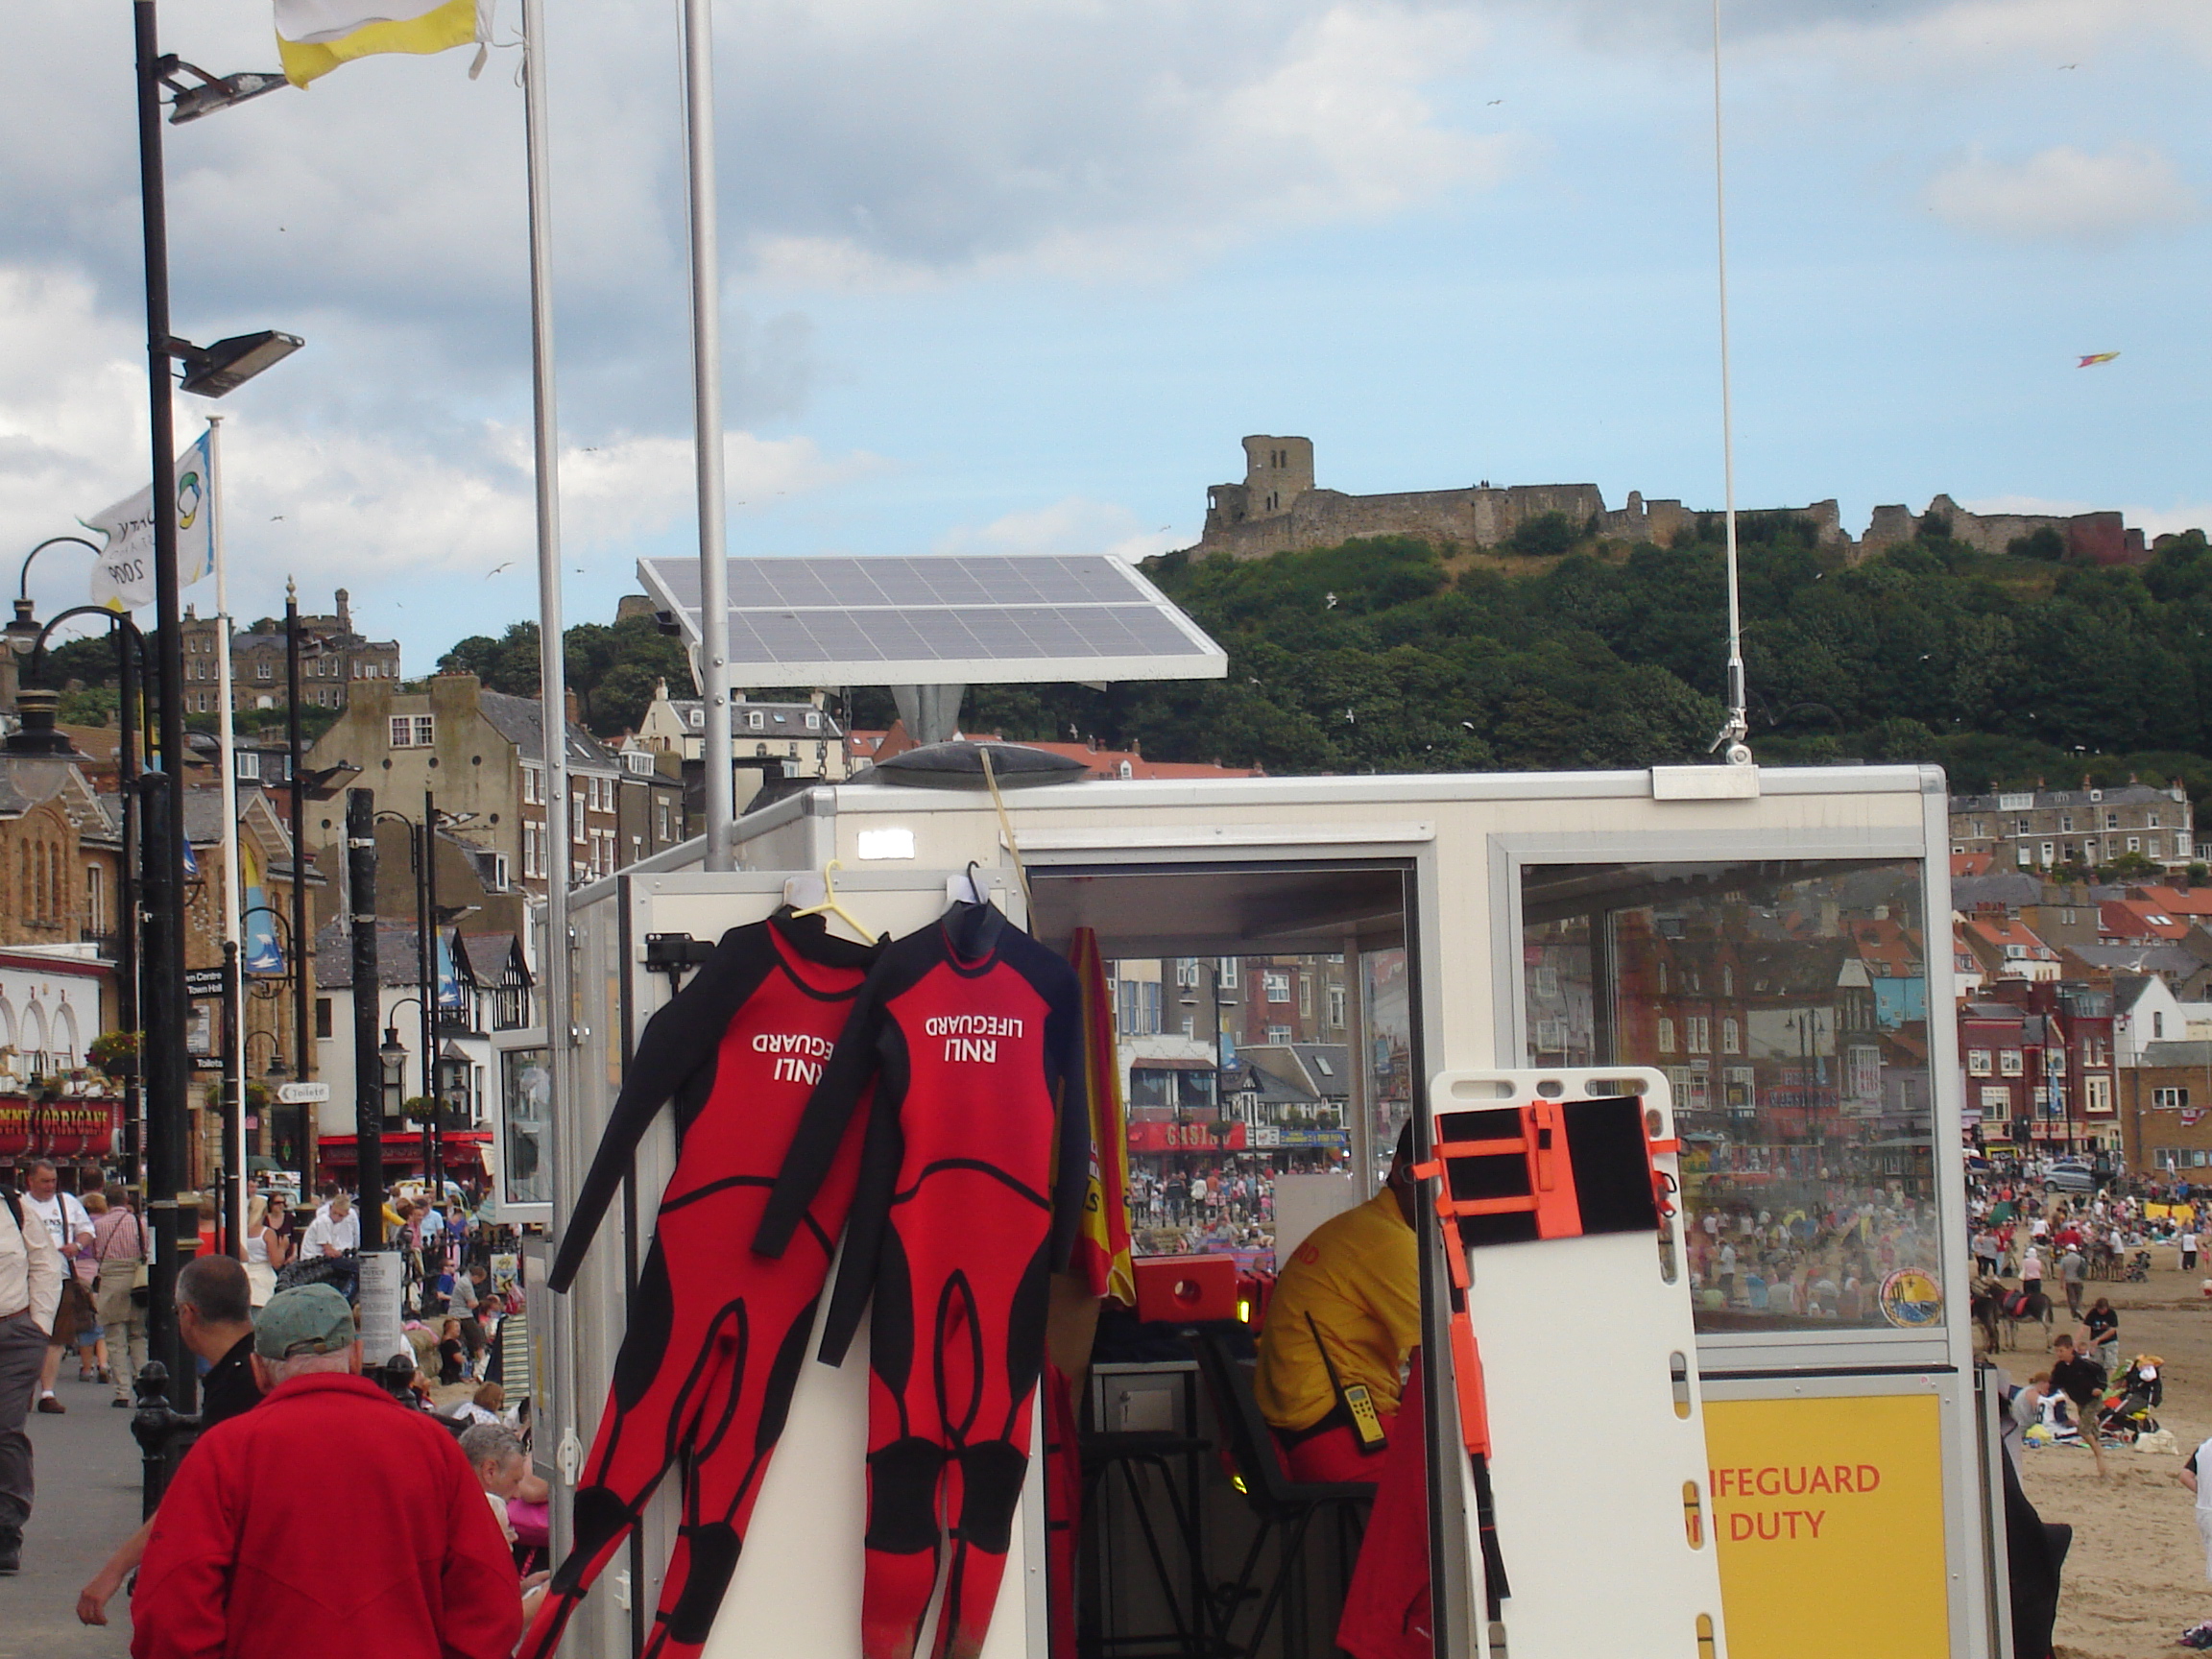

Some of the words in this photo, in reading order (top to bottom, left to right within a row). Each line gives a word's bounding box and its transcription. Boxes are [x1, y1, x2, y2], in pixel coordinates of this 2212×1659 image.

[196, 972, 223, 981] Centre
[186, 985, 208, 995] Town
[208, 983, 223, 993] Hall
[926, 1015, 1023, 1038] LIFEGUARD
[752, 1034, 834, 1061] EGUARD
[944, 1039, 997, 1063] RNLI
[196, 1059, 223, 1069] Toilets
[1709, 1464, 1881, 1498] IFEGUARD
[1731, 1510, 1826, 1542] DUTY
